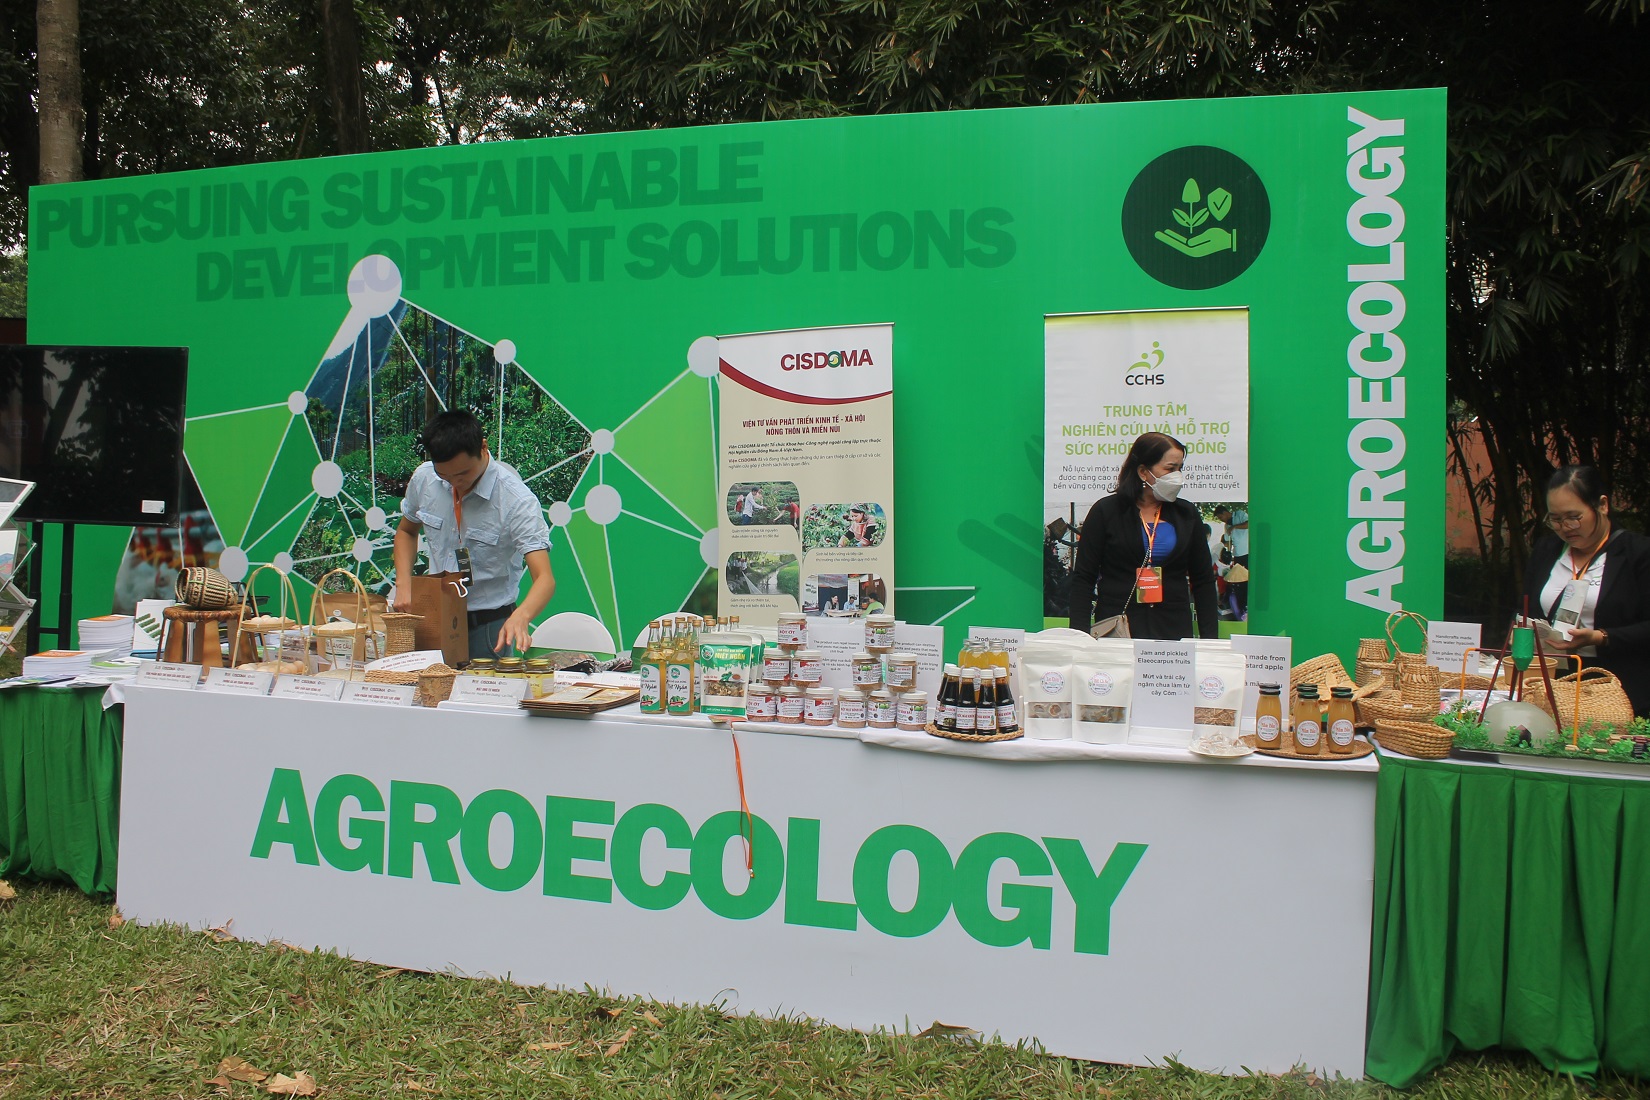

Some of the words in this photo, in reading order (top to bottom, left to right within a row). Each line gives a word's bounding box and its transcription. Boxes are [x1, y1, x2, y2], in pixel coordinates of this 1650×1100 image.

[36, 176, 309, 251] PURSUING
[320, 141, 764, 230] SUSTAINABLE
[196, 225, 615, 301] DEVELOPMENT
[623, 206, 1017, 280] SOLUTIONS
[780, 349, 873, 371] CISDOMA
[1346, 105, 1406, 616] AGROECOLOGY
[1125, 374, 1164, 385] CCHS
[1103, 405, 1152, 417] TRUNG
[1156, 401, 1187, 416] TÂM
[742, 420, 755, 428] VIỆN
[765, 417, 778, 426] VẤN
[779, 417, 795, 425] PHÁT
[796, 415, 814, 424] TRIỂN
[832, 414, 839, 423] TẾ
[854, 413, 865, 423] HỘI
[1062, 422, 1116, 436] NGHIÊN
[1120, 420, 1149, 435] CỨU
[1153, 422, 1172, 435] VÀ
[1176, 418, 1196, 435] HỖ
[1200, 421, 1230, 437] TRỢ
[766, 427, 783, 435] NÔNG
[785, 426, 800, 434] THÔN
[802, 426, 810, 434] VÀ
[811, 424, 828, 433] MIỀN
[829, 424, 840, 433] NÚI
[1065, 441, 1093, 455] SỨC
[1074, 465, 1085, 473] lực
[1059, 474, 1076, 482] được
[1078, 475, 1096, 483] nâng
[1185, 472, 1194, 480] để
[1196, 473, 1213, 481] phát
[1215, 472, 1233, 480] triển
[1068, 482, 1085, 490] vững
[1208, 482, 1216, 490] tự
[1218, 481, 1240, 490] quyết
[249, 767, 1150, 956] AGROECOLOGY
